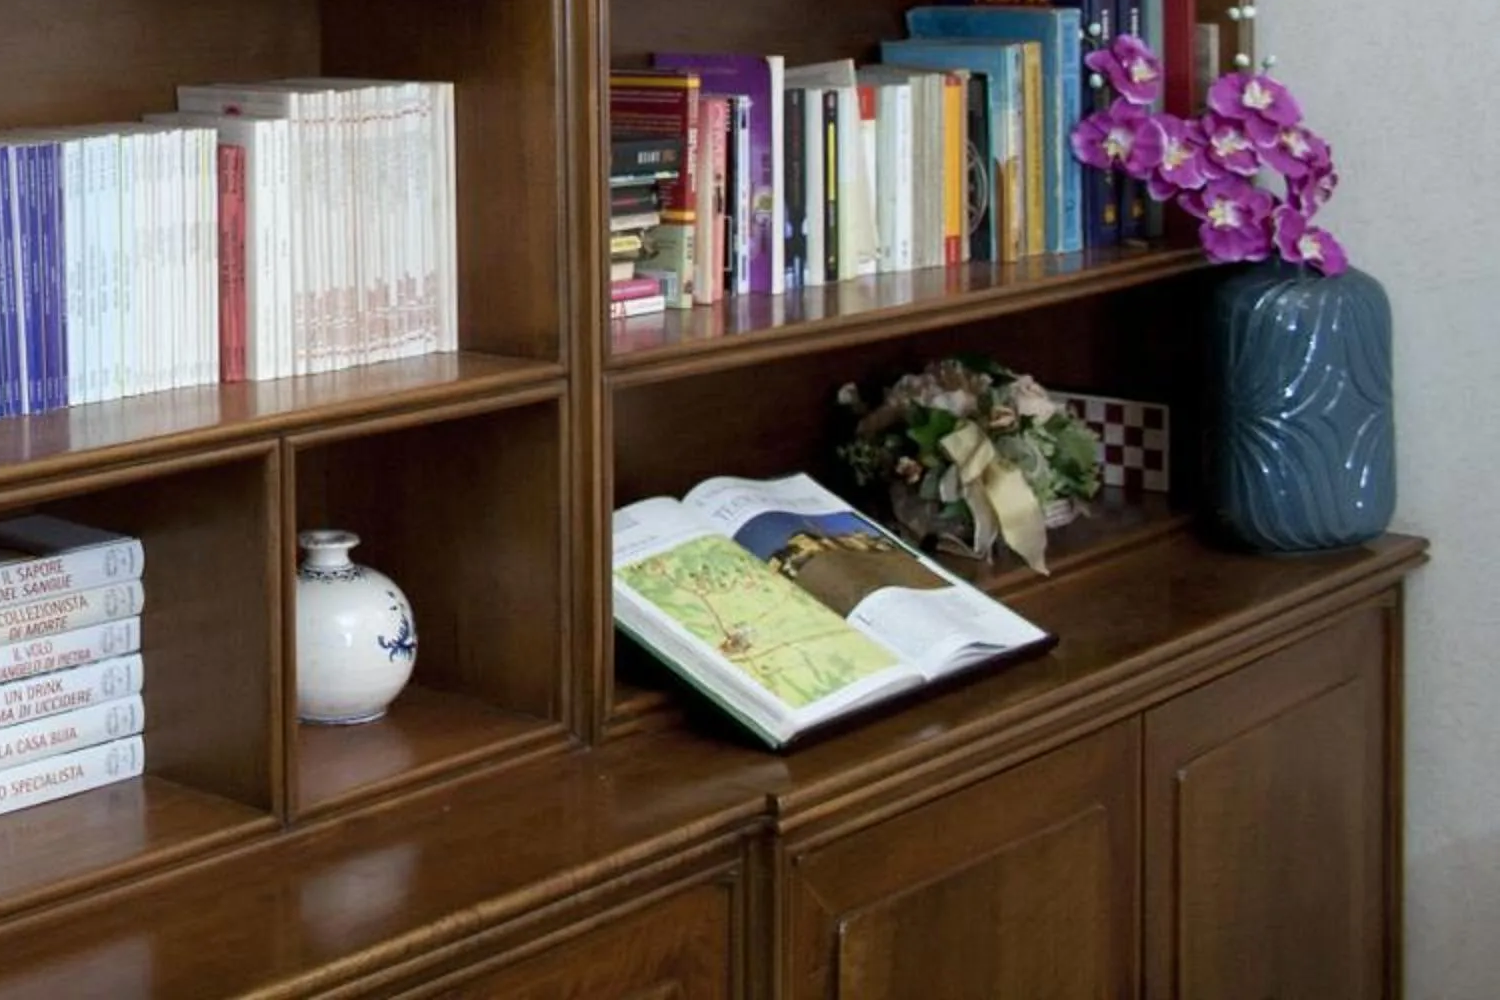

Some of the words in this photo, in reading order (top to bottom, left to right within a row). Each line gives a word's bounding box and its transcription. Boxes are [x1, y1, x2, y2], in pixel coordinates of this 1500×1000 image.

[1, 571, 15, 585] IL
[17, 558, 64, 577] SAPORE
[23, 574, 73, 597] SANGUE
[8, 628, 23, 642] DI
[25, 614, 69, 636] MORTE
[26, 641, 54, 659] VOLO
[3, 690, 25, 706] UN
[28, 679, 64, 700] DRINK
[18, 703, 32, 717] DI
[35, 688, 93, 714] UCCIDERE
[17, 734, 48, 757] CASA
[49, 727, 79, 747] BUIA
[12, 764, 85, 796] SPECIALISTA
